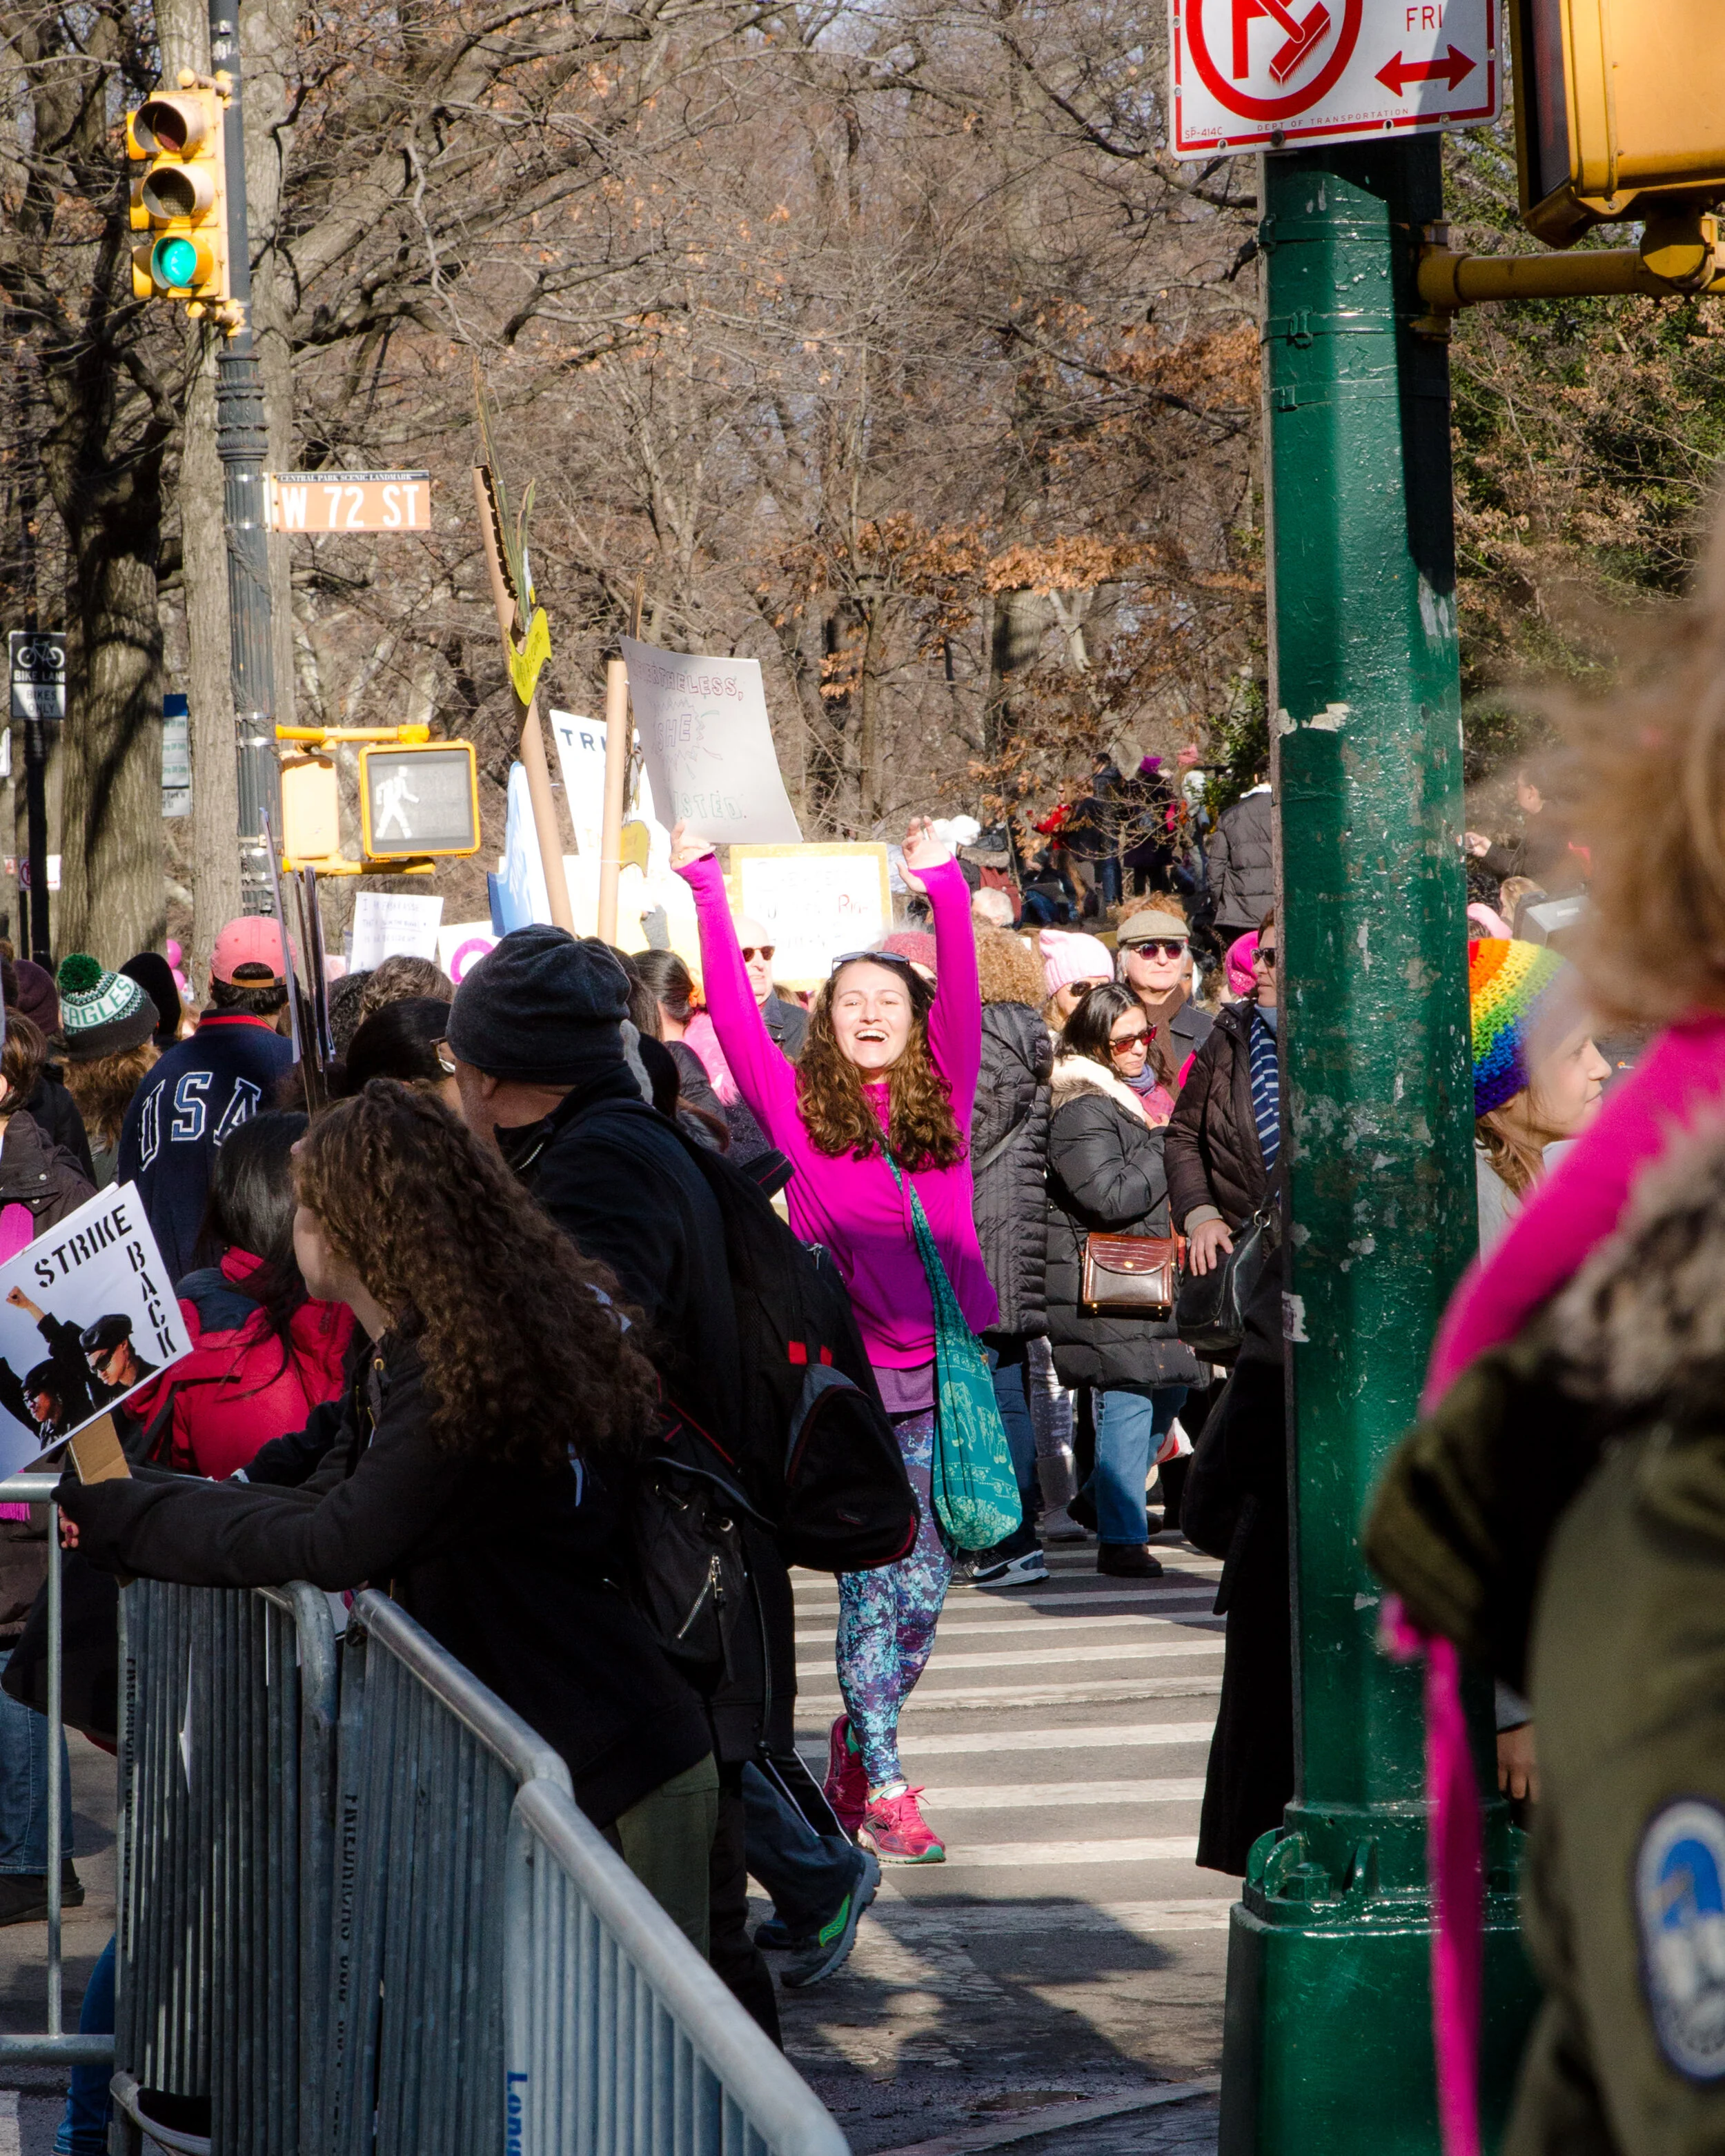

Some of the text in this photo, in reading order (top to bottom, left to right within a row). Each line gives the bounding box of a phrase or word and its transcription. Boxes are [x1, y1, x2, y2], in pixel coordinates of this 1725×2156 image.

[1406, 4, 1443, 32] FRI
[1257, 108, 1409, 132] DEPT OF TRANSPORTATION
[370, 473, 413, 481] LANDMARK
[281, 484, 420, 528] W 72 ST
[14, 670, 37, 681] BIKE
[26, 690, 57, 701] BIKES
[28, 703, 55, 714] ONLY
[658, 713, 692, 752] SHE
[62, 978, 132, 1025] EAGLES
[139, 1071, 262, 1172] USA
[34, 1204, 132, 1289] STRIKE
[127, 1240, 178, 1359] BACK
